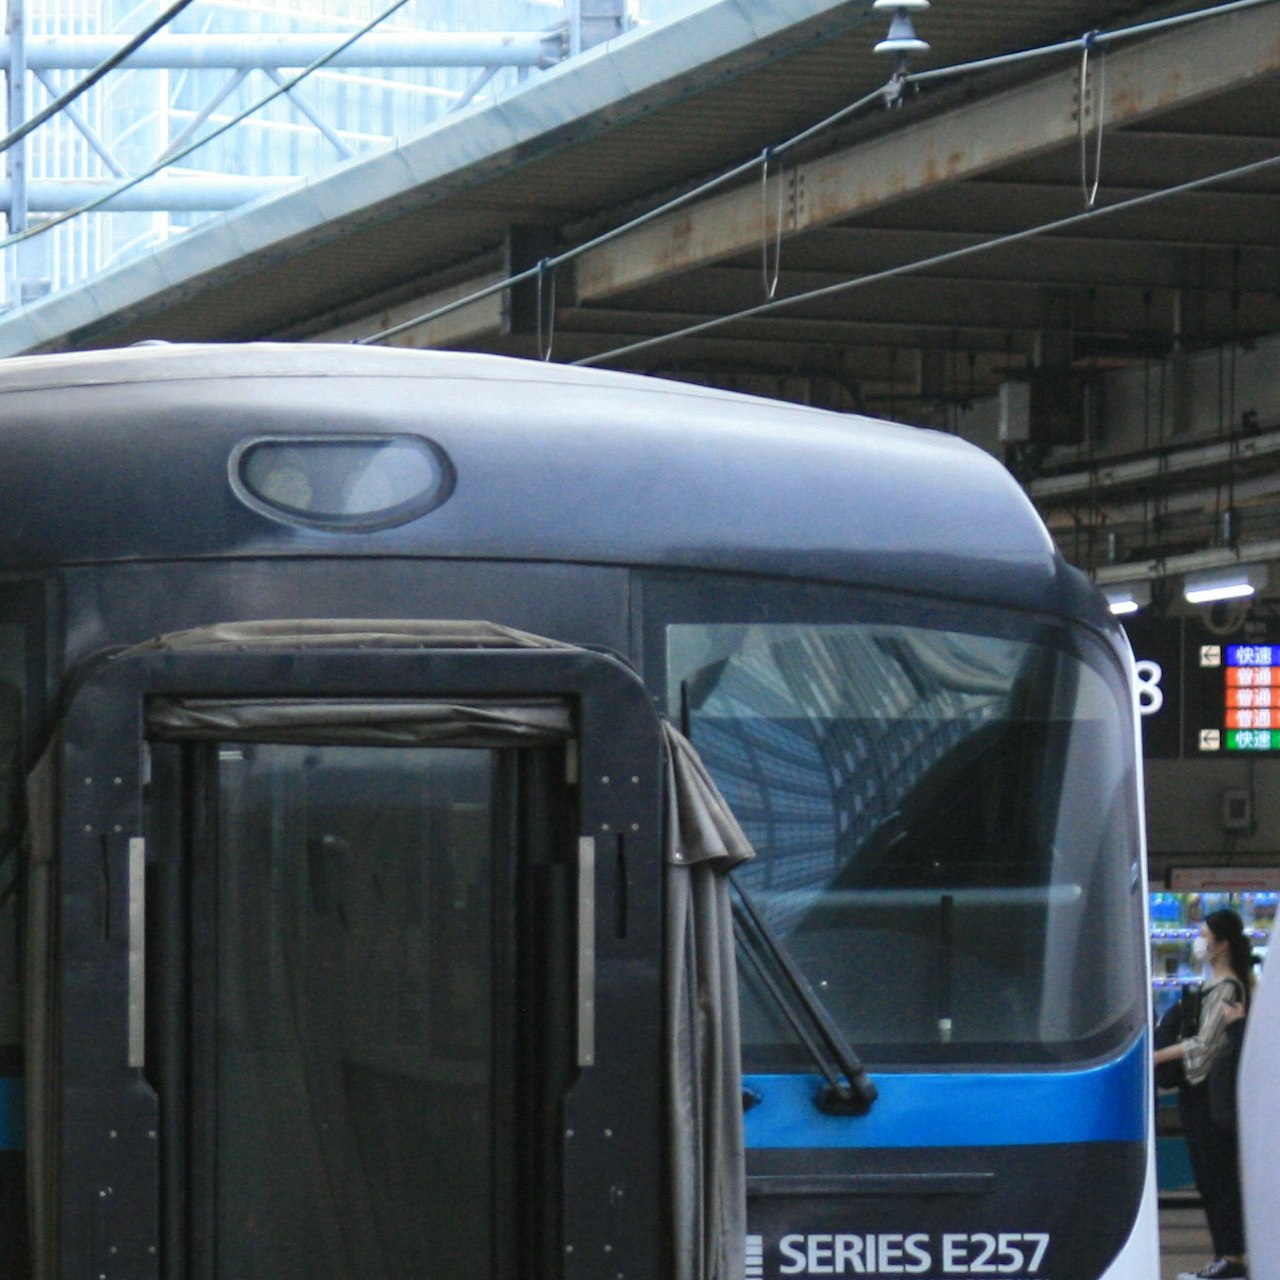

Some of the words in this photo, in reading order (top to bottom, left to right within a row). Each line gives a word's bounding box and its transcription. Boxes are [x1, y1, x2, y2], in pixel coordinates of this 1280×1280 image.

[1236, 645, 1272, 666] 快速
[1136, 660, 1163, 715] 8
[1236, 730, 1271, 749] 快速
[779, 1233, 932, 1274] SERIES
[942, 1233, 1050, 1273] E257
